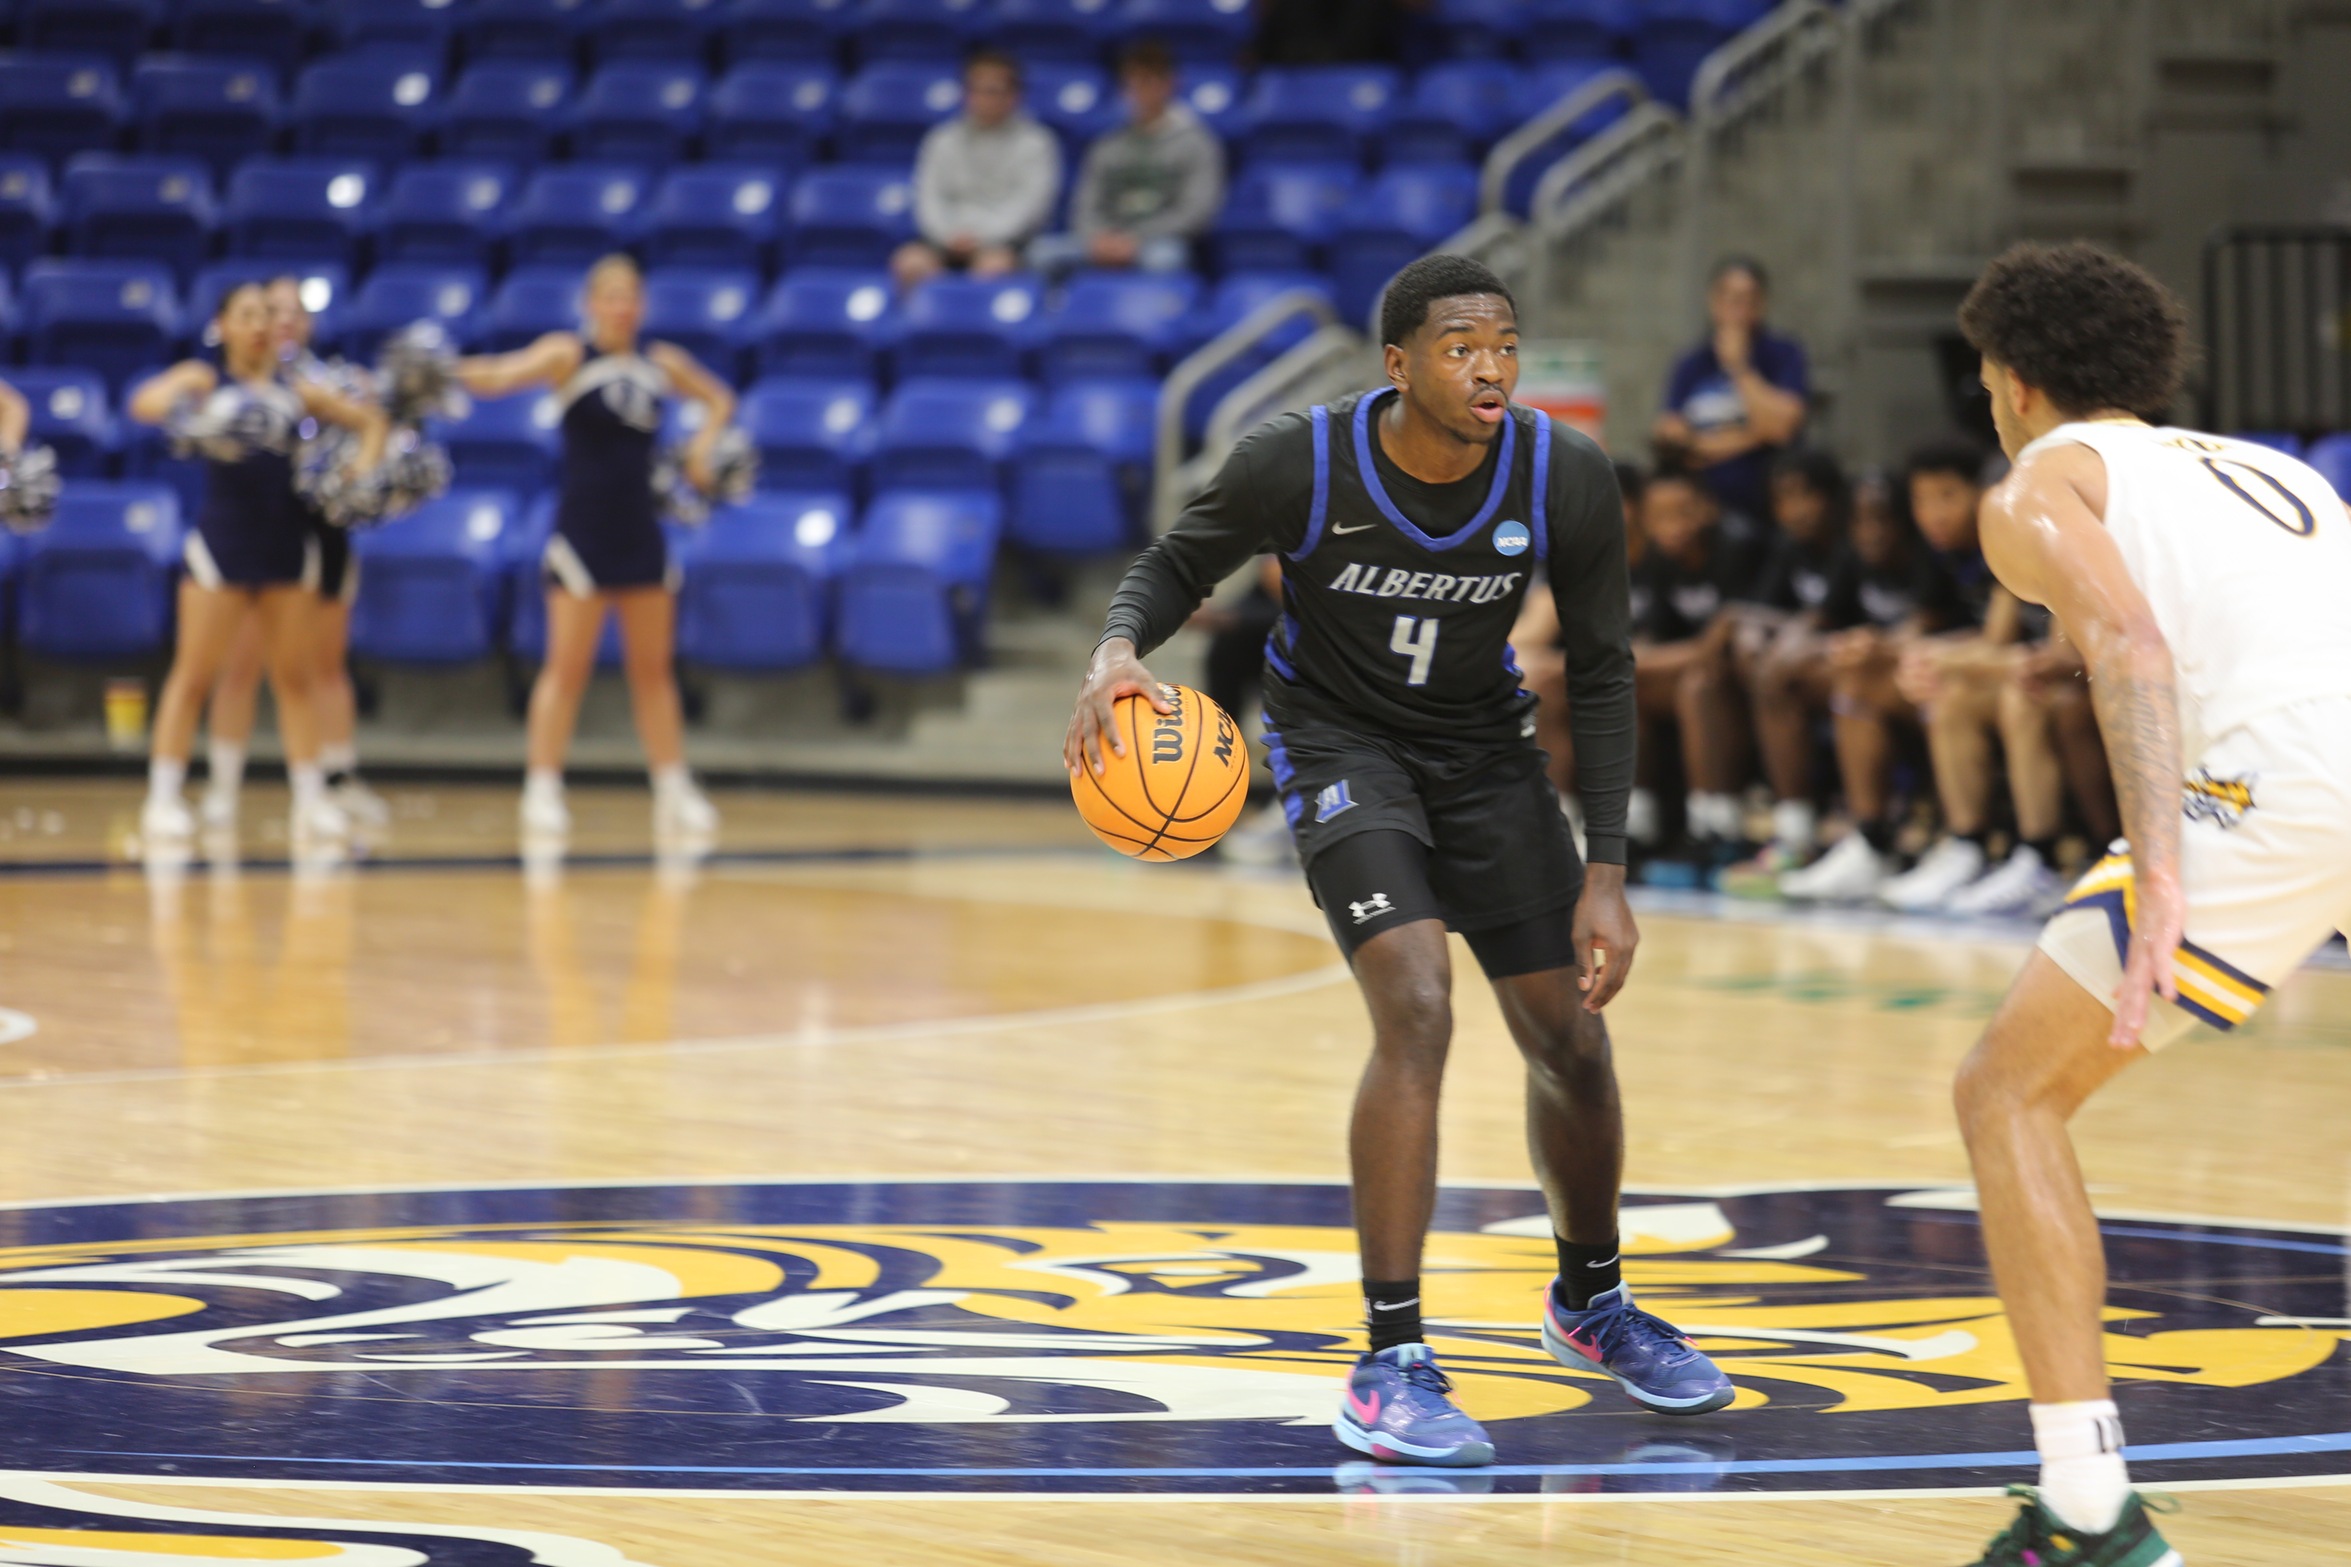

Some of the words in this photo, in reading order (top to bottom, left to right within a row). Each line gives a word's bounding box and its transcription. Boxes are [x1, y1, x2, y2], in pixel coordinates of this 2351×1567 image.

[2199, 456, 2316, 538] 0
[1328, 562, 1523, 605] ALBERTUS
[1389, 614, 1440, 687] 4
